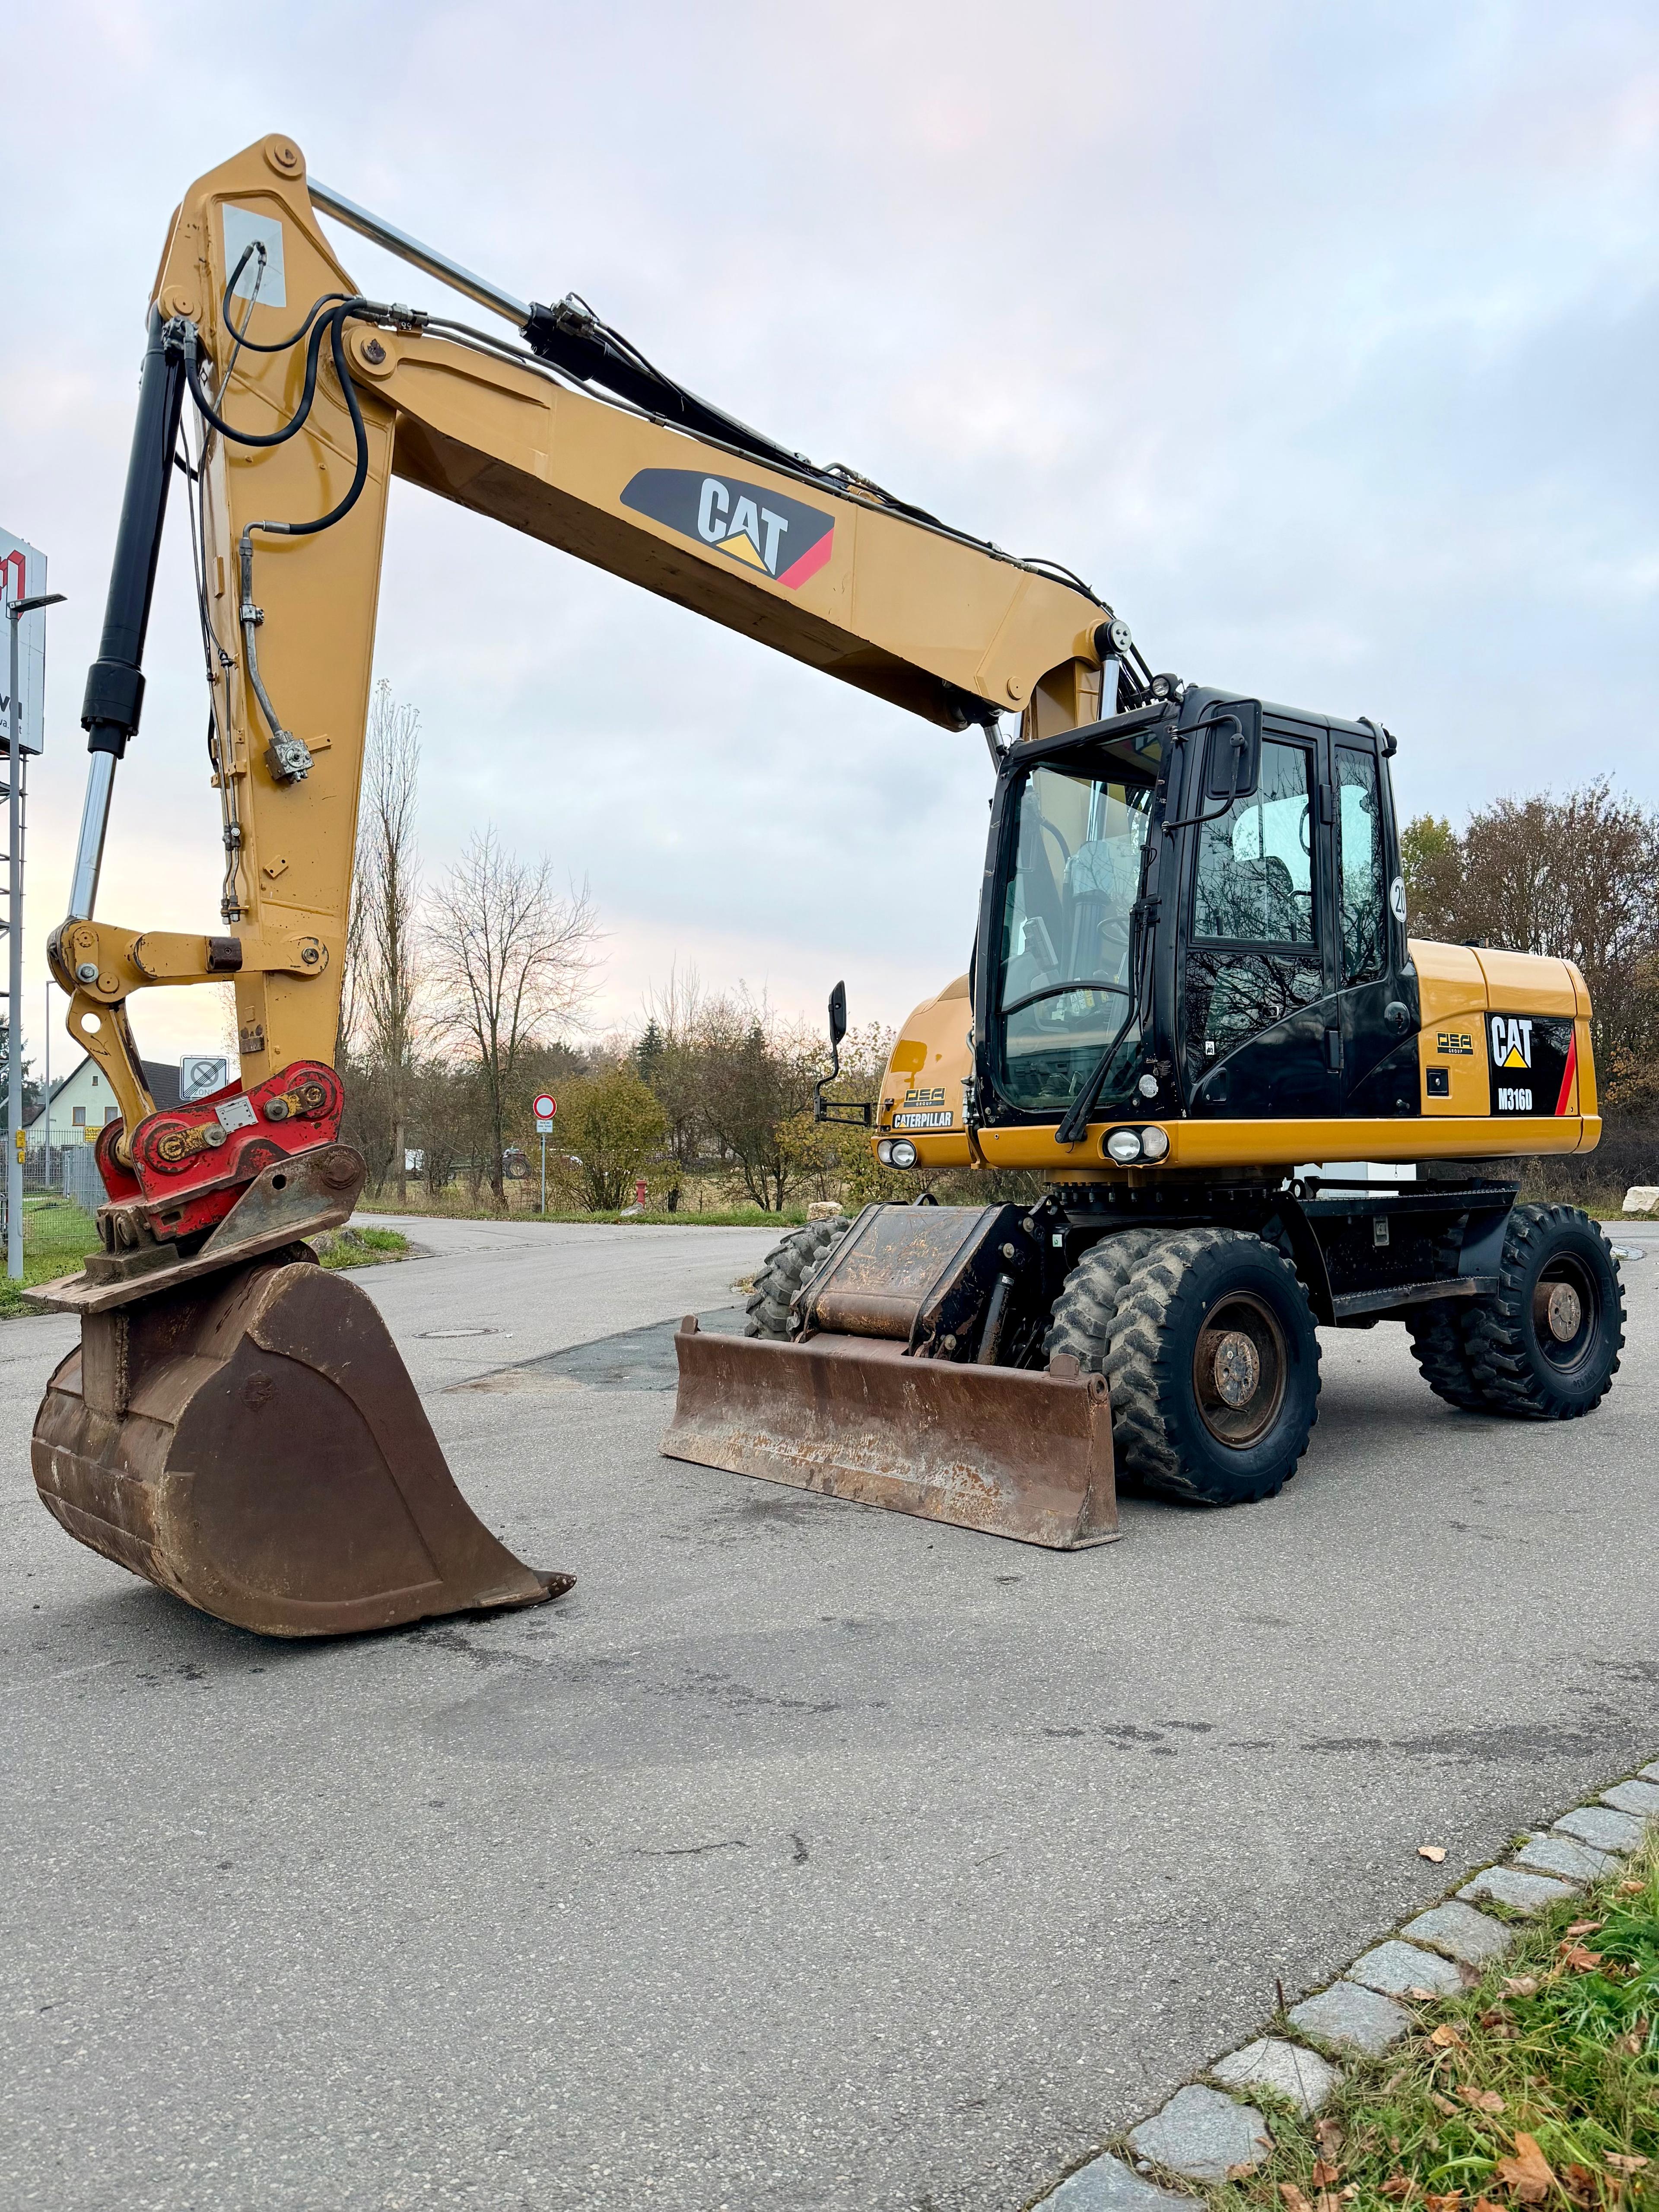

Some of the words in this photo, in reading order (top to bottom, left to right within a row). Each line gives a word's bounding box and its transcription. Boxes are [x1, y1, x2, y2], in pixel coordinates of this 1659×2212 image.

[698, 478, 788, 575] CAT
[1395, 885, 1405, 914] 20
[1491, 1016, 1532, 1068] CAT
[1498, 1088, 1532, 1110] M316D
[894, 1112, 951, 1128] CATERPILLAR
